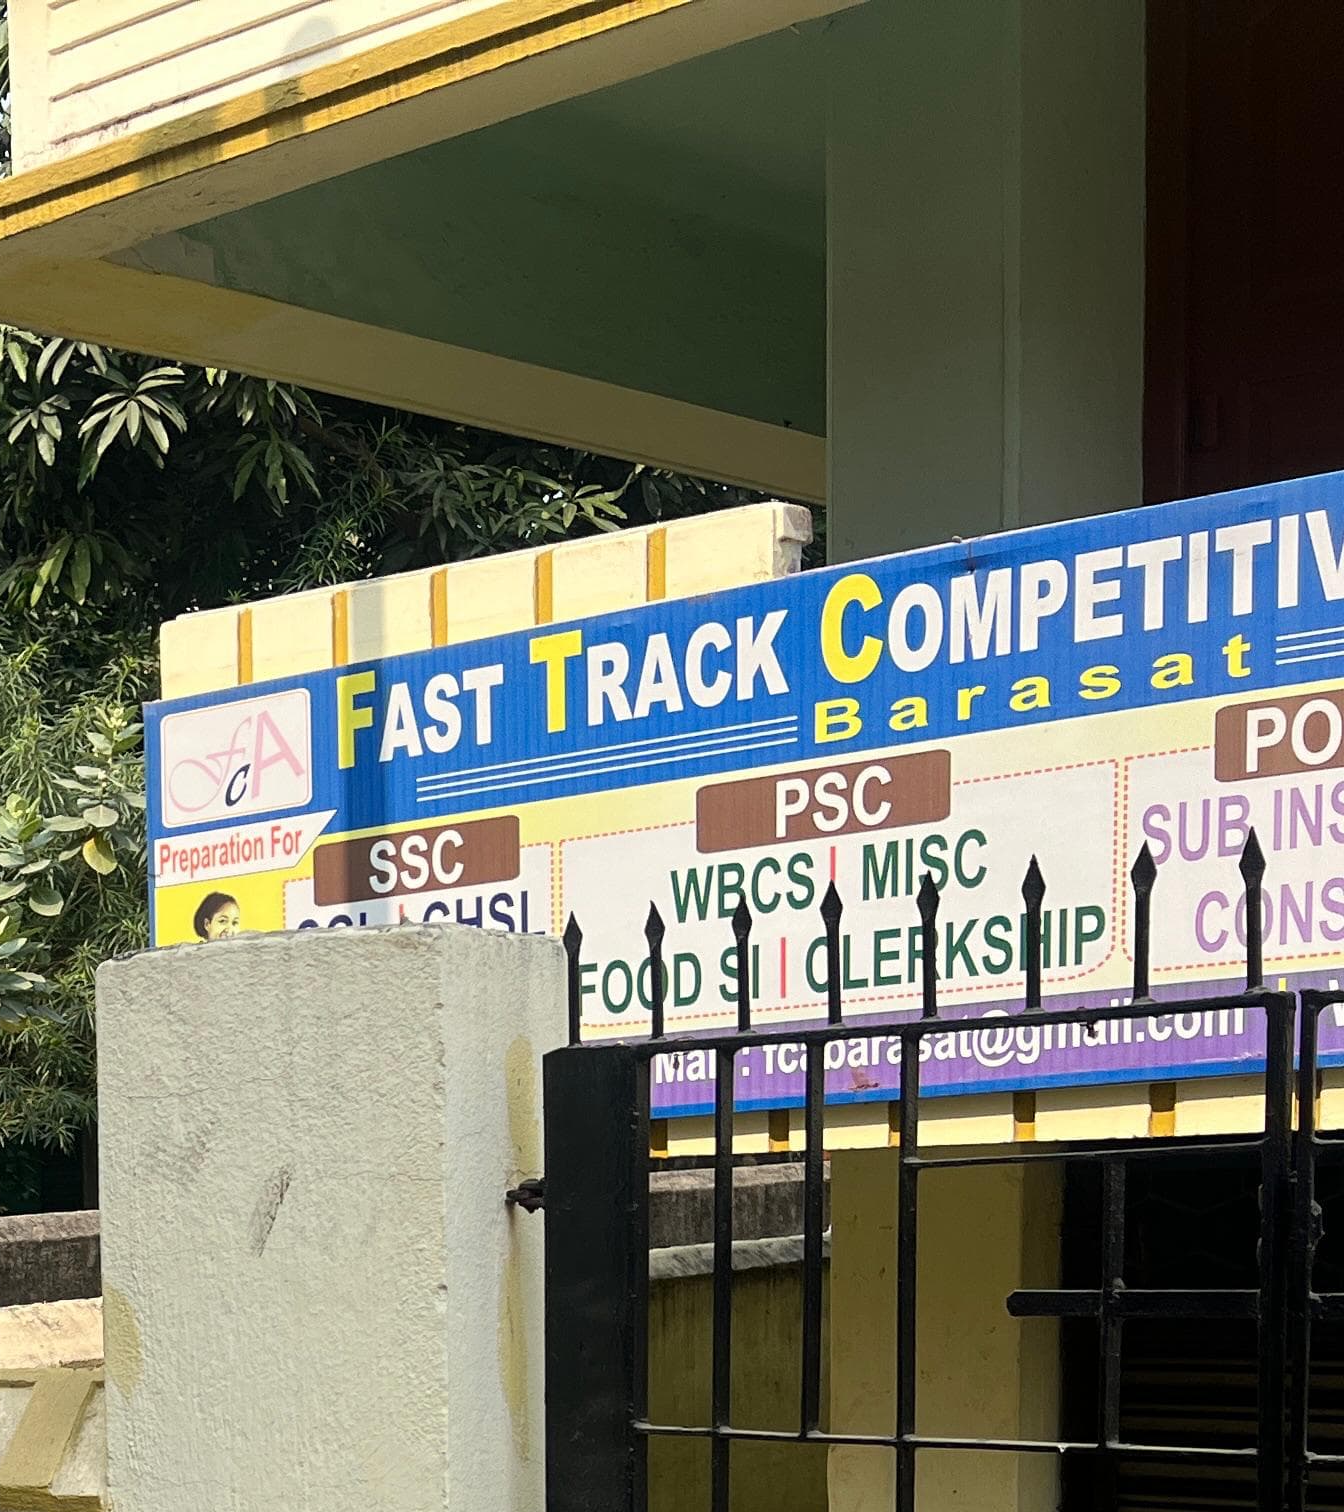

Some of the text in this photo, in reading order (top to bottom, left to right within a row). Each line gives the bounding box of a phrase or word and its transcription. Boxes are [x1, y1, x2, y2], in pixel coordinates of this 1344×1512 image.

[336, 664, 503, 770] FAST
[529, 608, 790, 733] TRACK
[814, 634, 1251, 745] Barasat
[776, 765, 892, 838] PSC
[1142, 794, 1250, 866] SUB
[159, 825, 302, 878] Preparation For
[369, 829, 464, 894] SSC
[671, 829, 988, 923] WBCS MISC
[805, 904, 1105, 994] CLERKSHIP
[764, 998, 1244, 1068] fcbarasat@gmail.com
